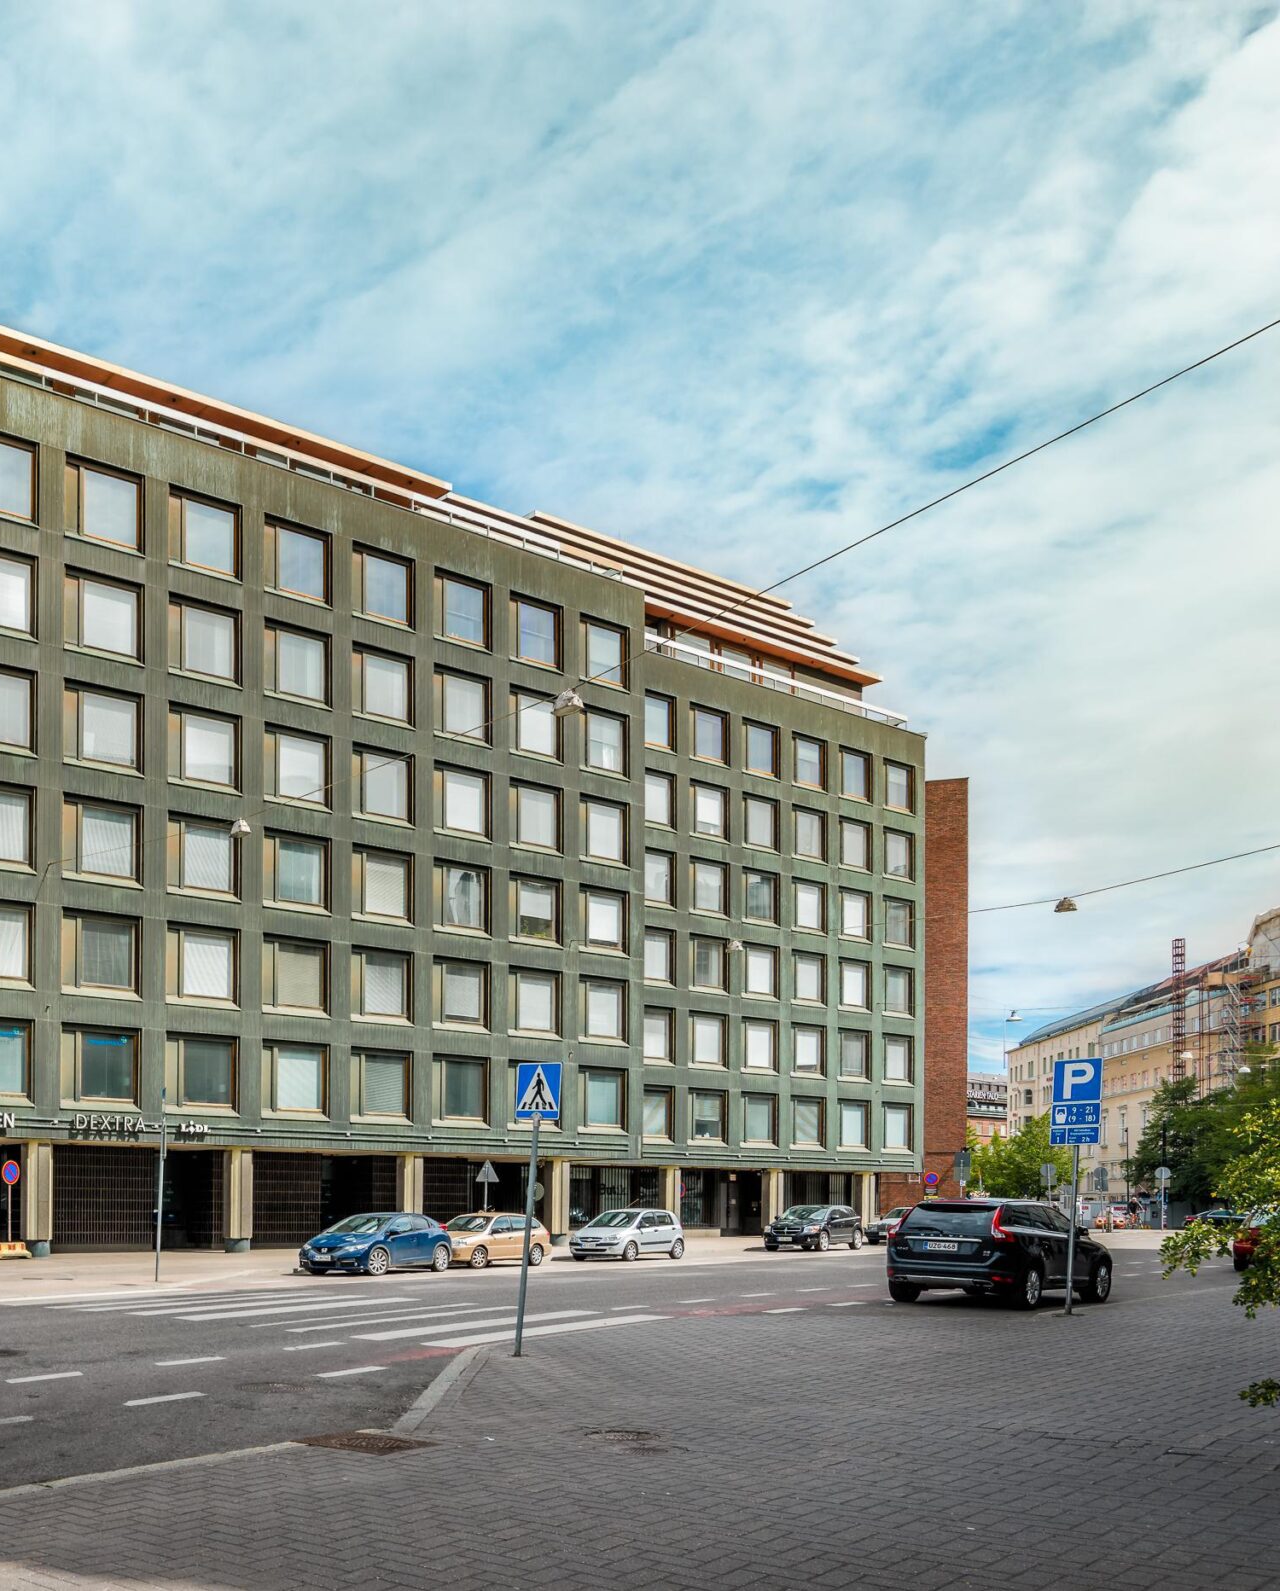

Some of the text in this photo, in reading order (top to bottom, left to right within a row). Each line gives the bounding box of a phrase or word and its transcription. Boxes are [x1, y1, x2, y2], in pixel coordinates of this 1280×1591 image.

[1062, 1062, 1095, 1100] P
[76, 1113, 146, 1132] DEXTRA
[1068, 1115, 1076, 1123] (9
